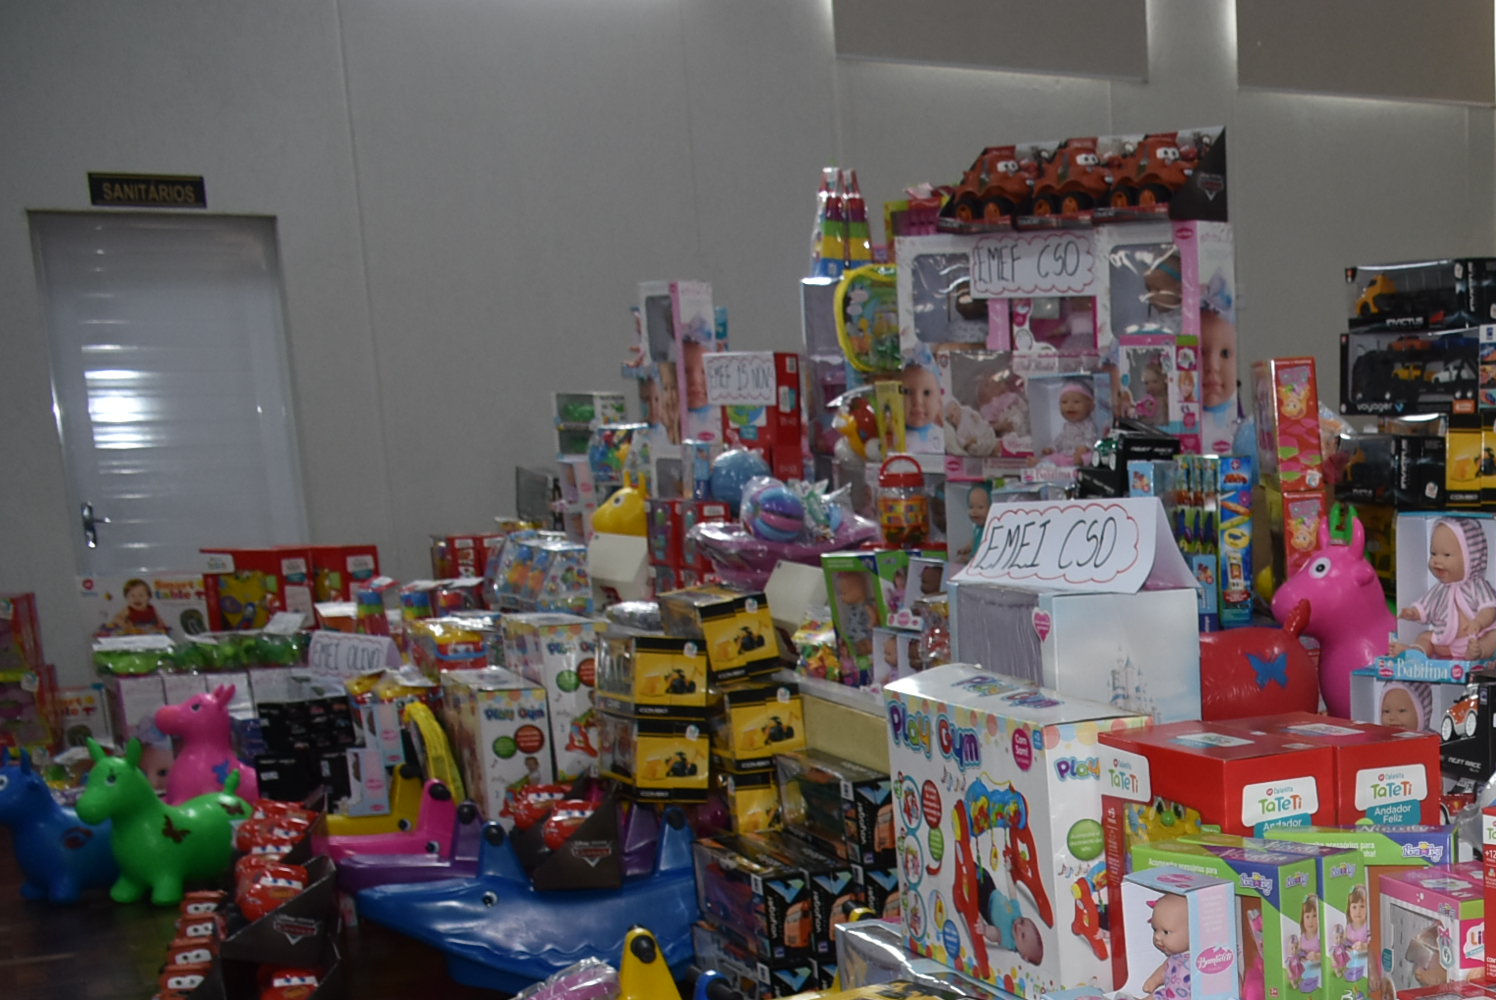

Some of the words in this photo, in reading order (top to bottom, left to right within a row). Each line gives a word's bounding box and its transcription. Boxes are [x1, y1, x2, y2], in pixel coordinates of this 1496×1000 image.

[102, 180, 196, 203] SANITÁRIOS
[976, 246, 1022, 284] EMEF
[1356, 402, 1393, 414] voyager
[975, 519, 1052, 570] EMEI
[1396, 658, 1450, 681] Babilina
[887, 699, 932, 760] Play
[935, 712, 982, 773] Gym
[1053, 756, 1101, 783] Play
[1108, 769, 1140, 794] TaTeTi
[1370, 780, 1413, 800] TaTeTi
[1258, 793, 1302, 816] TaTeTi
[1374, 803, 1413, 816] Andador
[1382, 812, 1404, 824] Feliz
